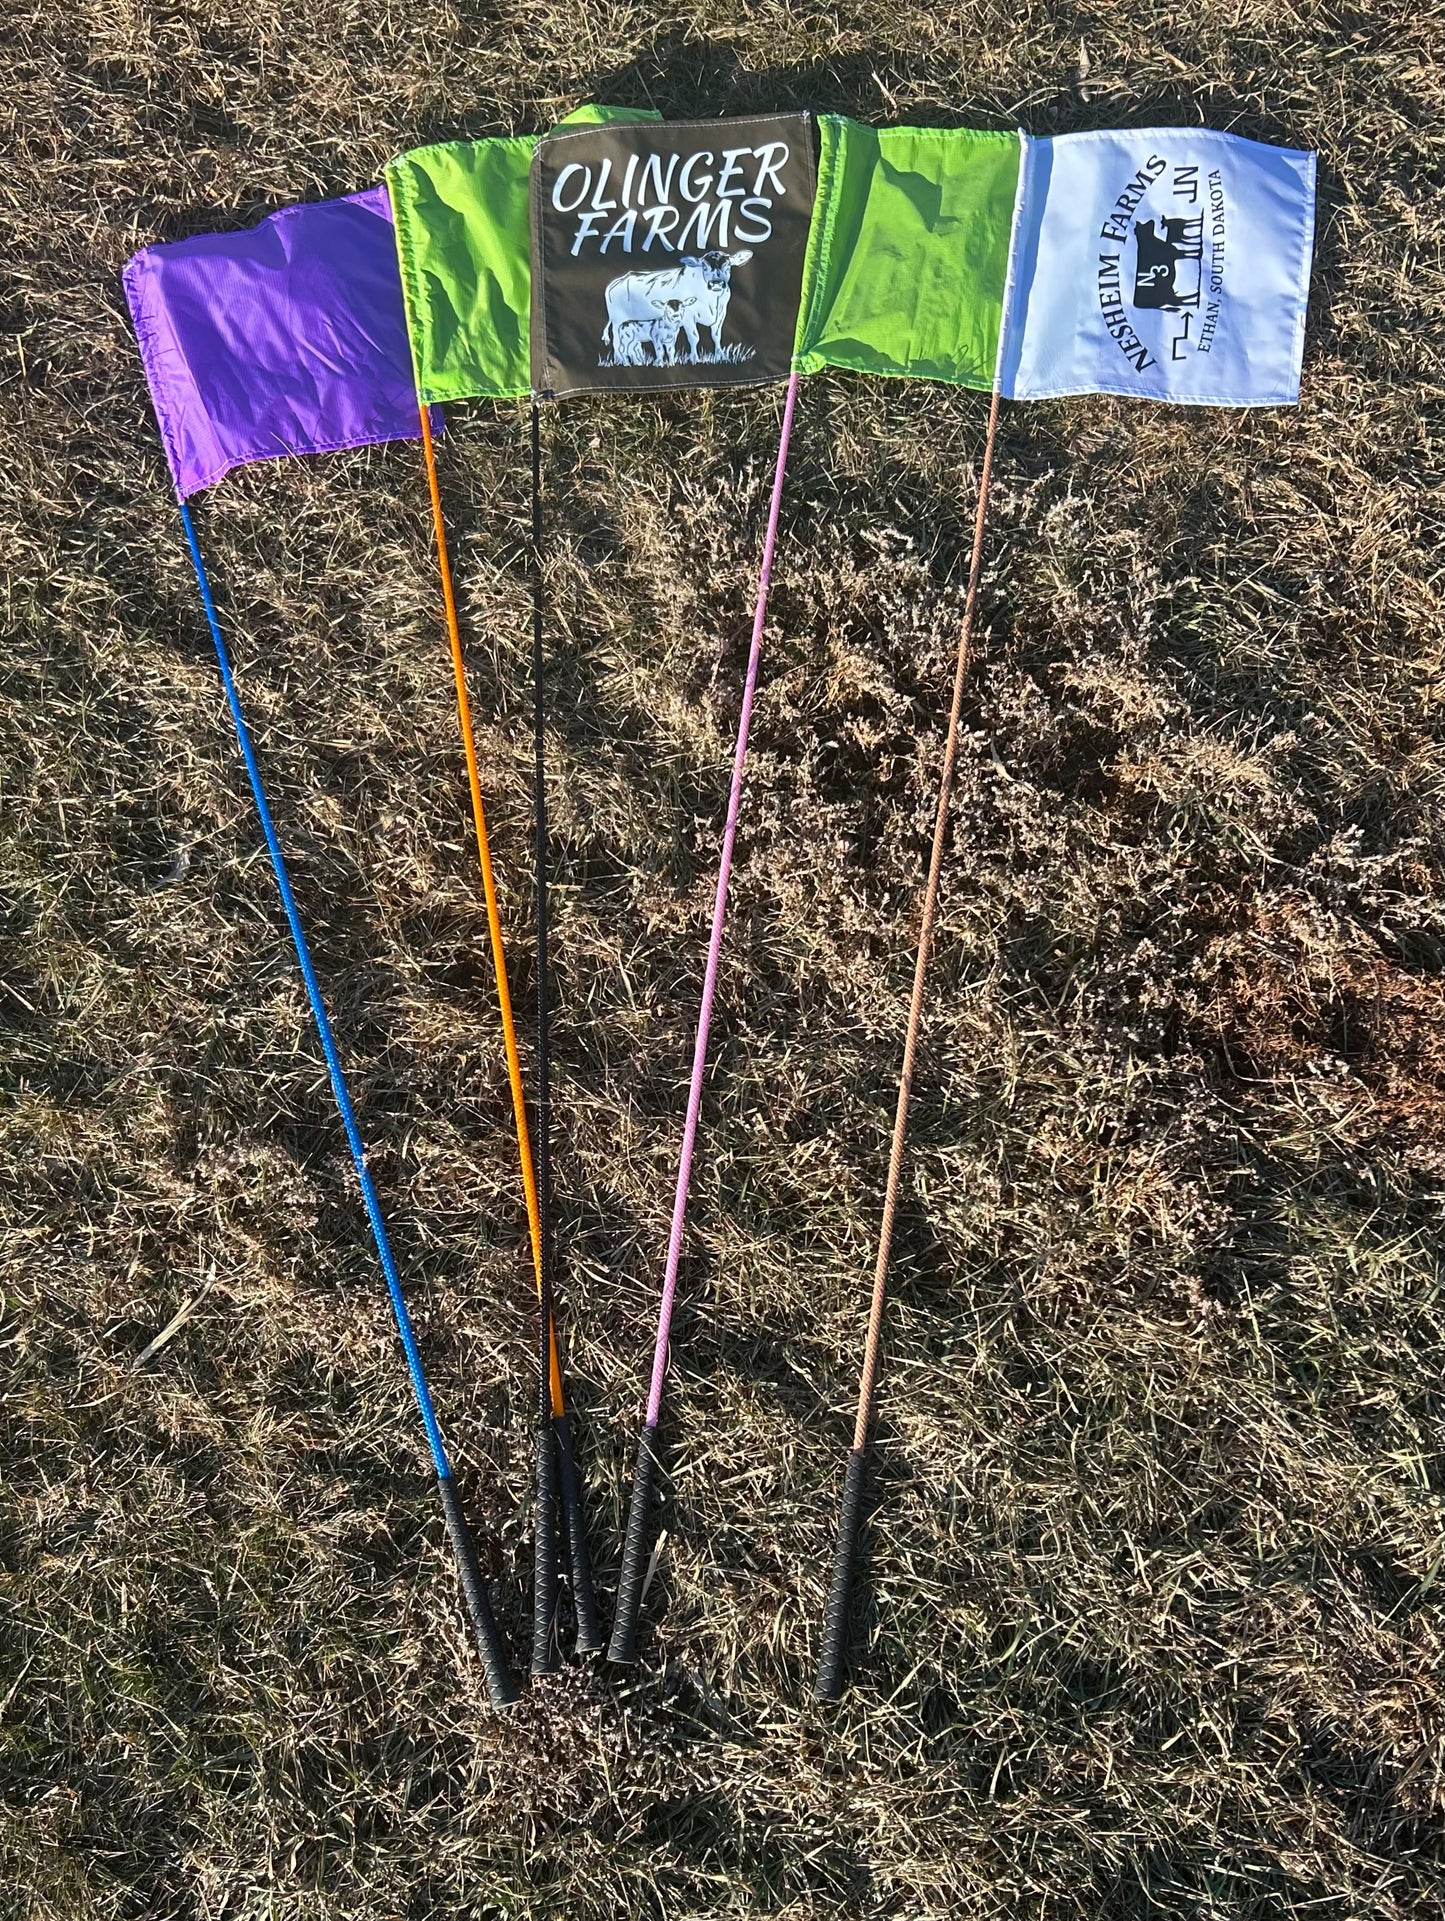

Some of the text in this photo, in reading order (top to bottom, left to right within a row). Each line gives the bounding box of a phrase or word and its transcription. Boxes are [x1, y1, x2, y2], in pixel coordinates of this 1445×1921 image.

[552, 141, 790, 213] OLINGER
[570, 197, 773, 257] FARMS
[1098, 154, 1167, 374] NESHEIM FARMS
[1197, 169, 1226, 353] ETHAN, SOUTH DAKOTA
